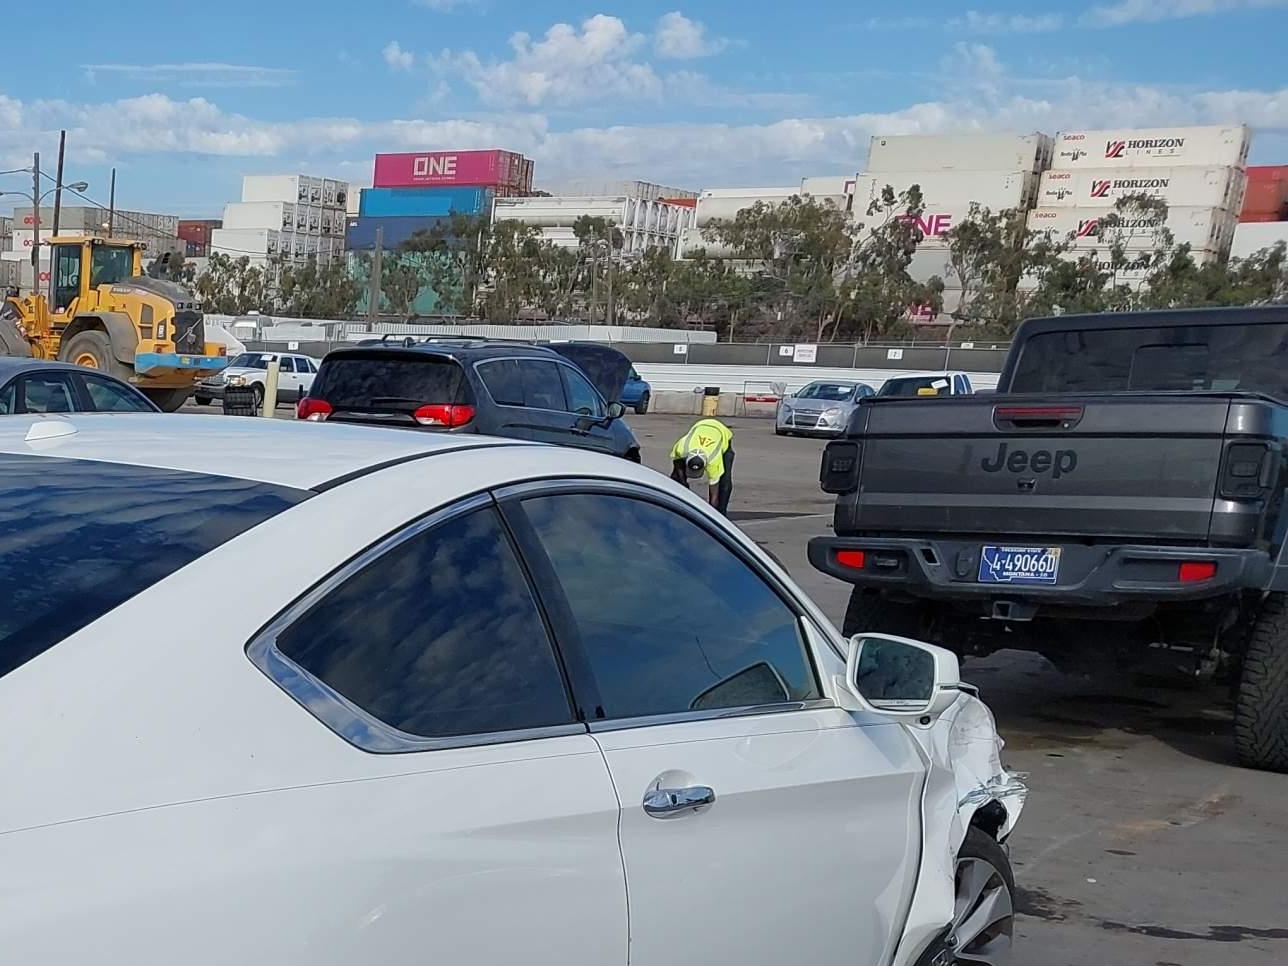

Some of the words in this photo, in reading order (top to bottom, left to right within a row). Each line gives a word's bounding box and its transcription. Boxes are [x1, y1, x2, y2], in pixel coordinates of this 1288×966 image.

[1128, 139, 1184, 148] HORIZON
[413, 156, 457, 176] ONE
[1113, 179, 1169, 188] HORIZON
[981, 442, 1078, 479] Jeep
